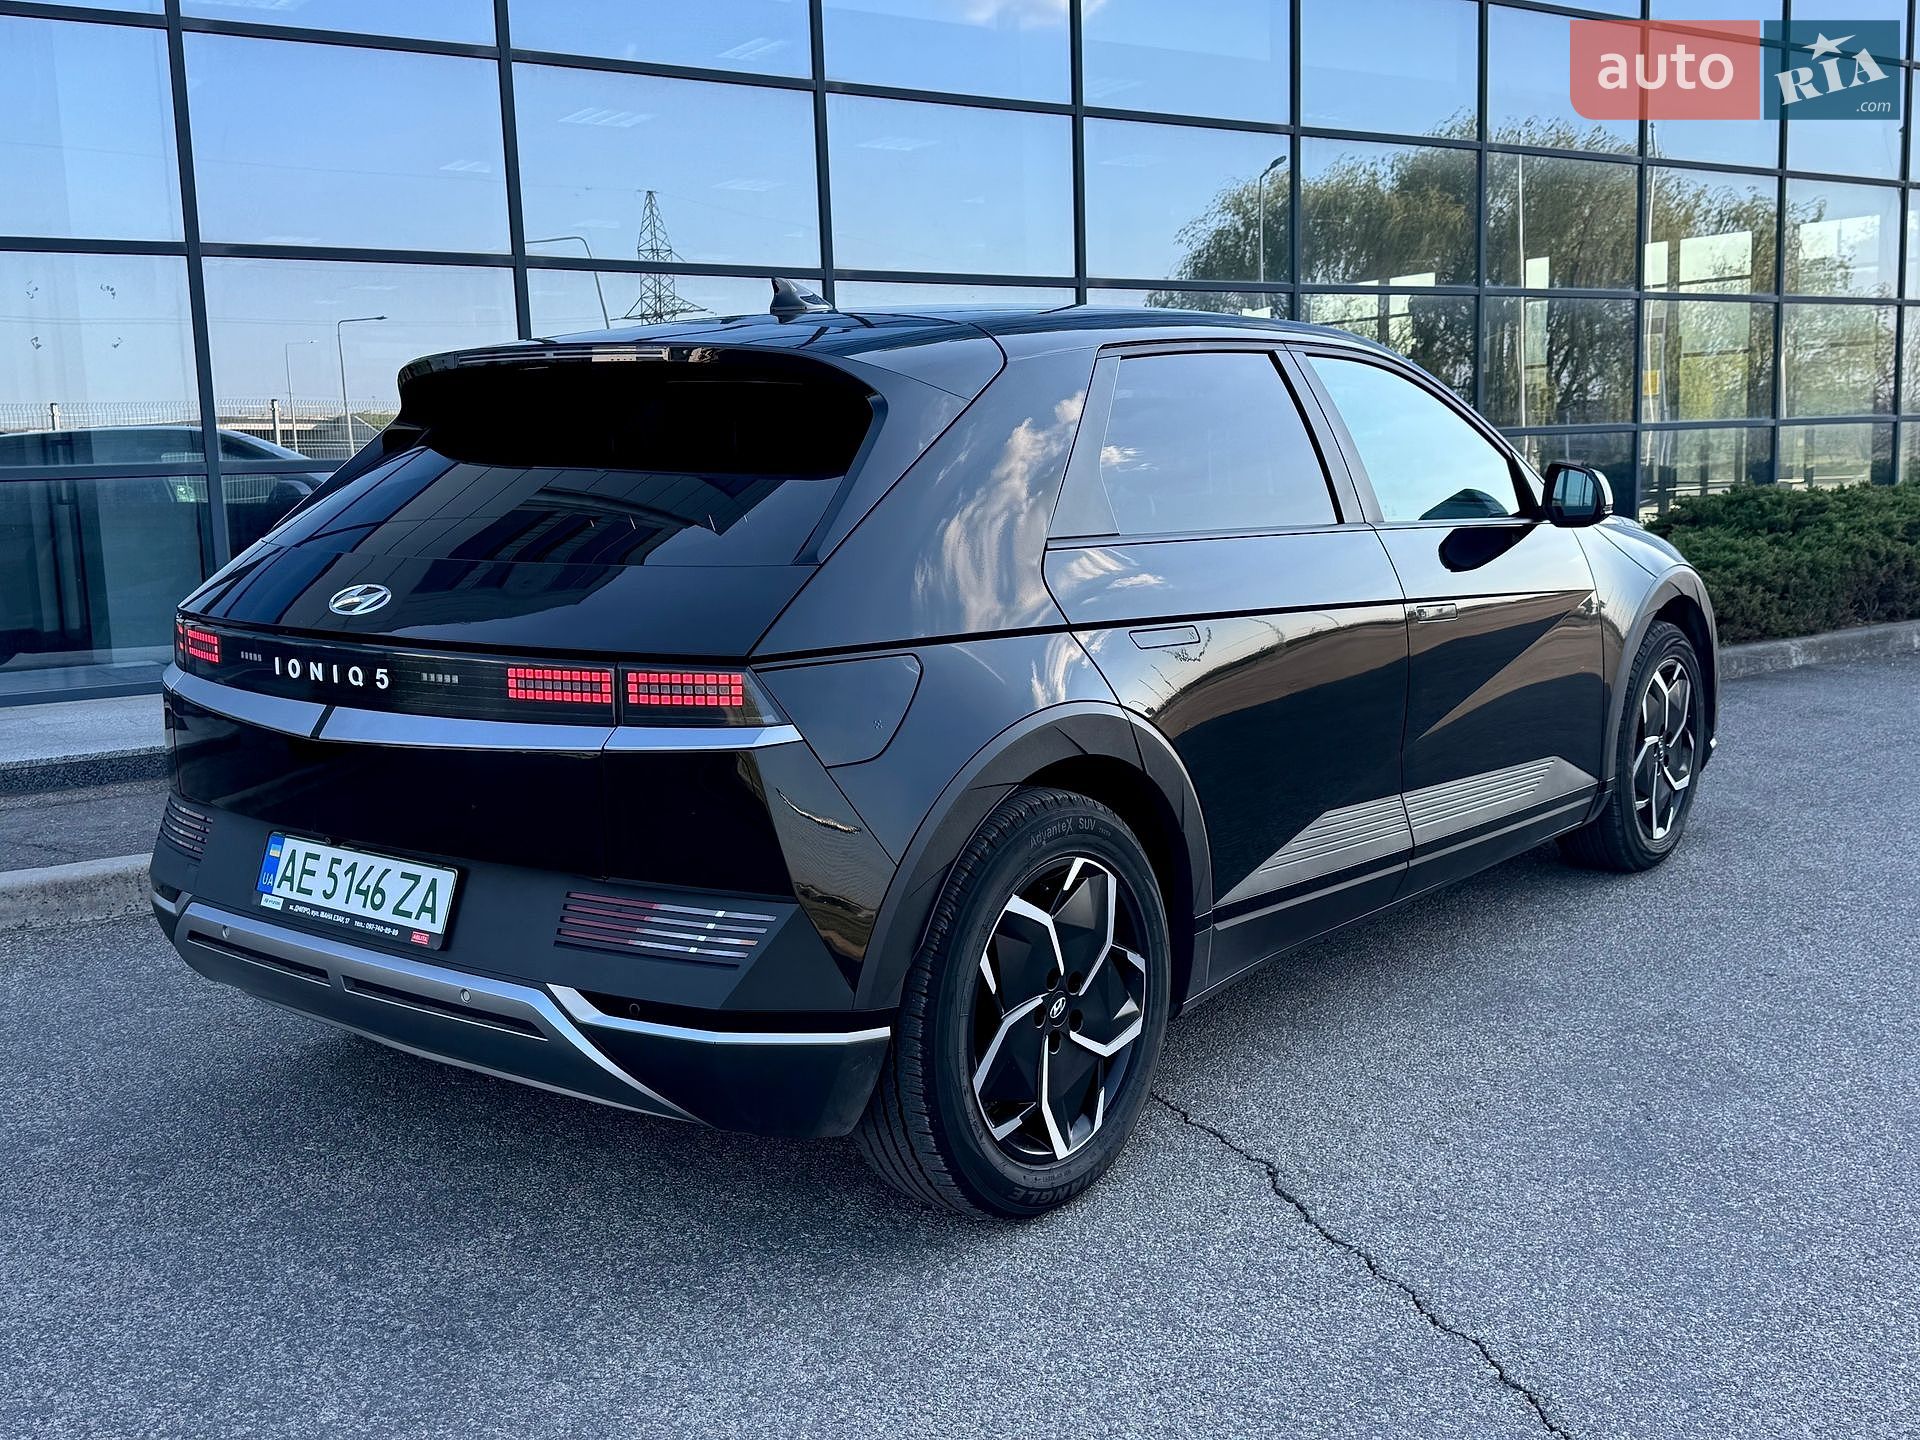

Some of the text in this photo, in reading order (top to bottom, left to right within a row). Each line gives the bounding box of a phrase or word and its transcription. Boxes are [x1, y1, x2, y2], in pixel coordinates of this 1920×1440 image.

[274, 656, 390, 689] IONIQ 5
[1030, 817, 1073, 848] AdvanteX
[1078, 817, 1096, 831] SUV
[262, 872, 274, 886] UA
[276, 849, 438, 924] AE 5146 ZA
